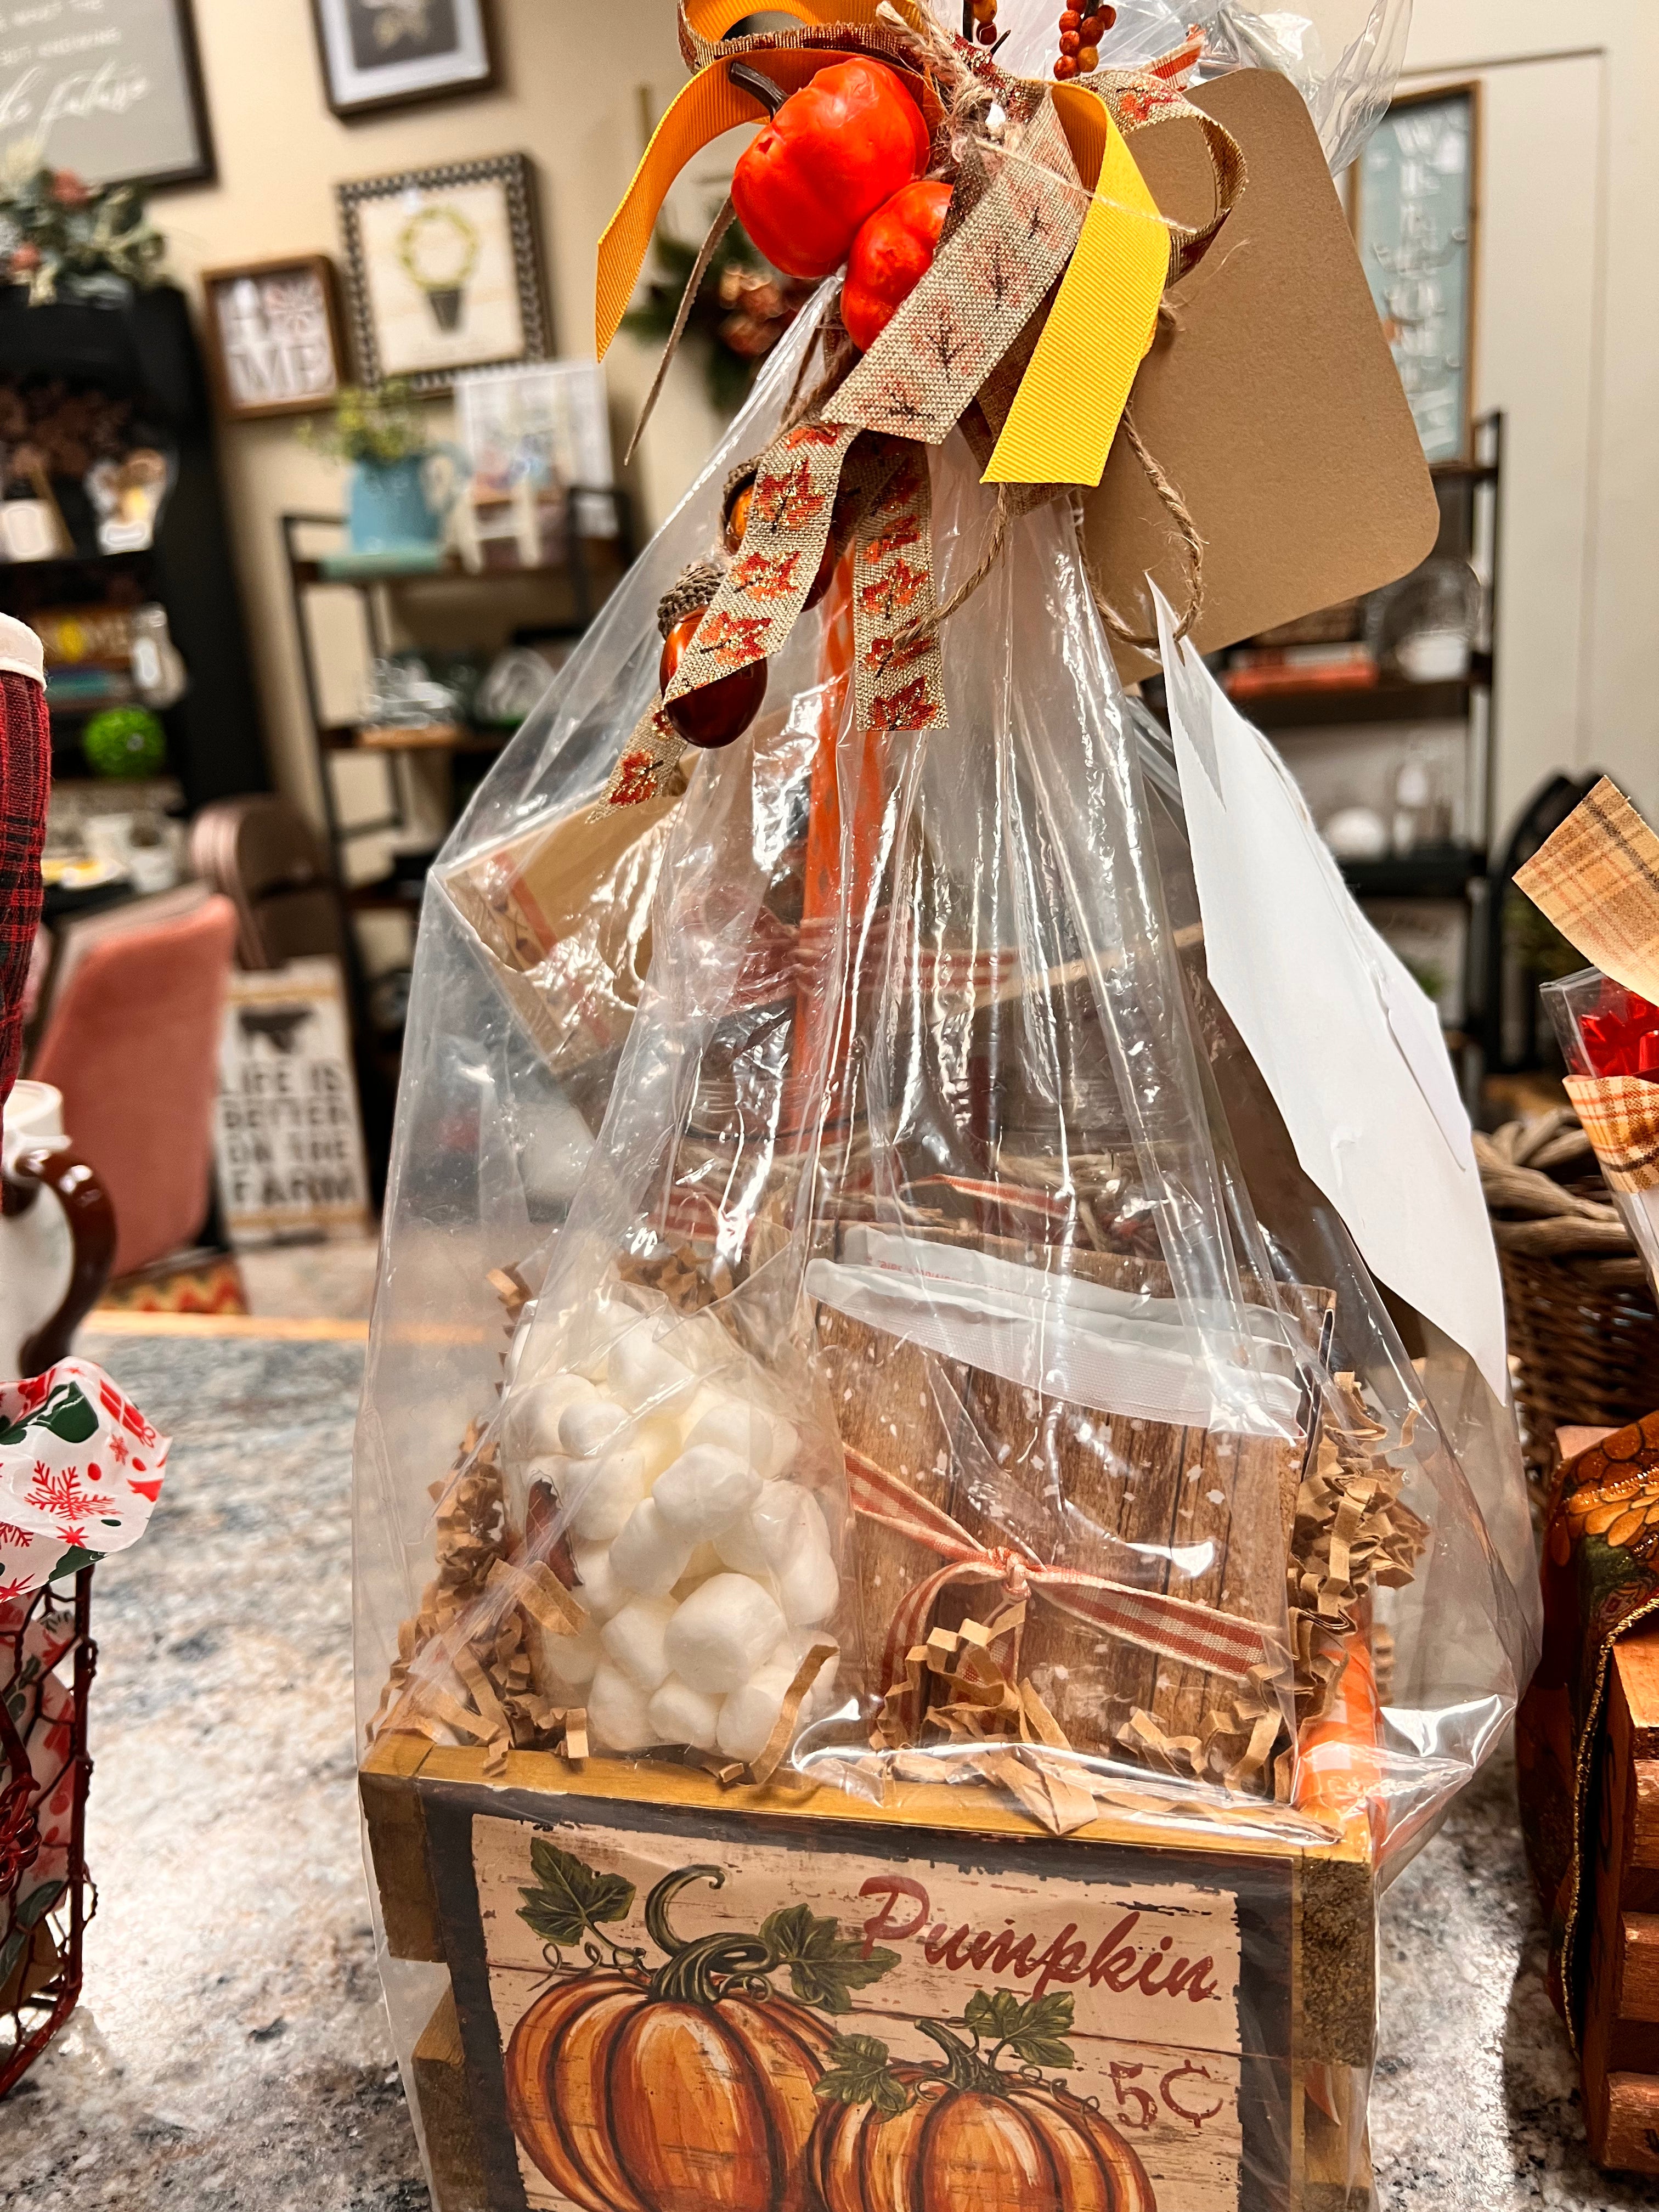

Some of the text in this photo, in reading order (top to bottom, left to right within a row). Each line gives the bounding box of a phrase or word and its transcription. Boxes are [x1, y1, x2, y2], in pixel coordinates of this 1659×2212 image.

[308, 1059, 343, 1093] IS
[222, 1095, 351, 1129] BETTER
[287, 1128, 348, 1162] THE
[232, 1164, 357, 1204] FARM
[859, 1875, 1219, 2004] Pumpkin
